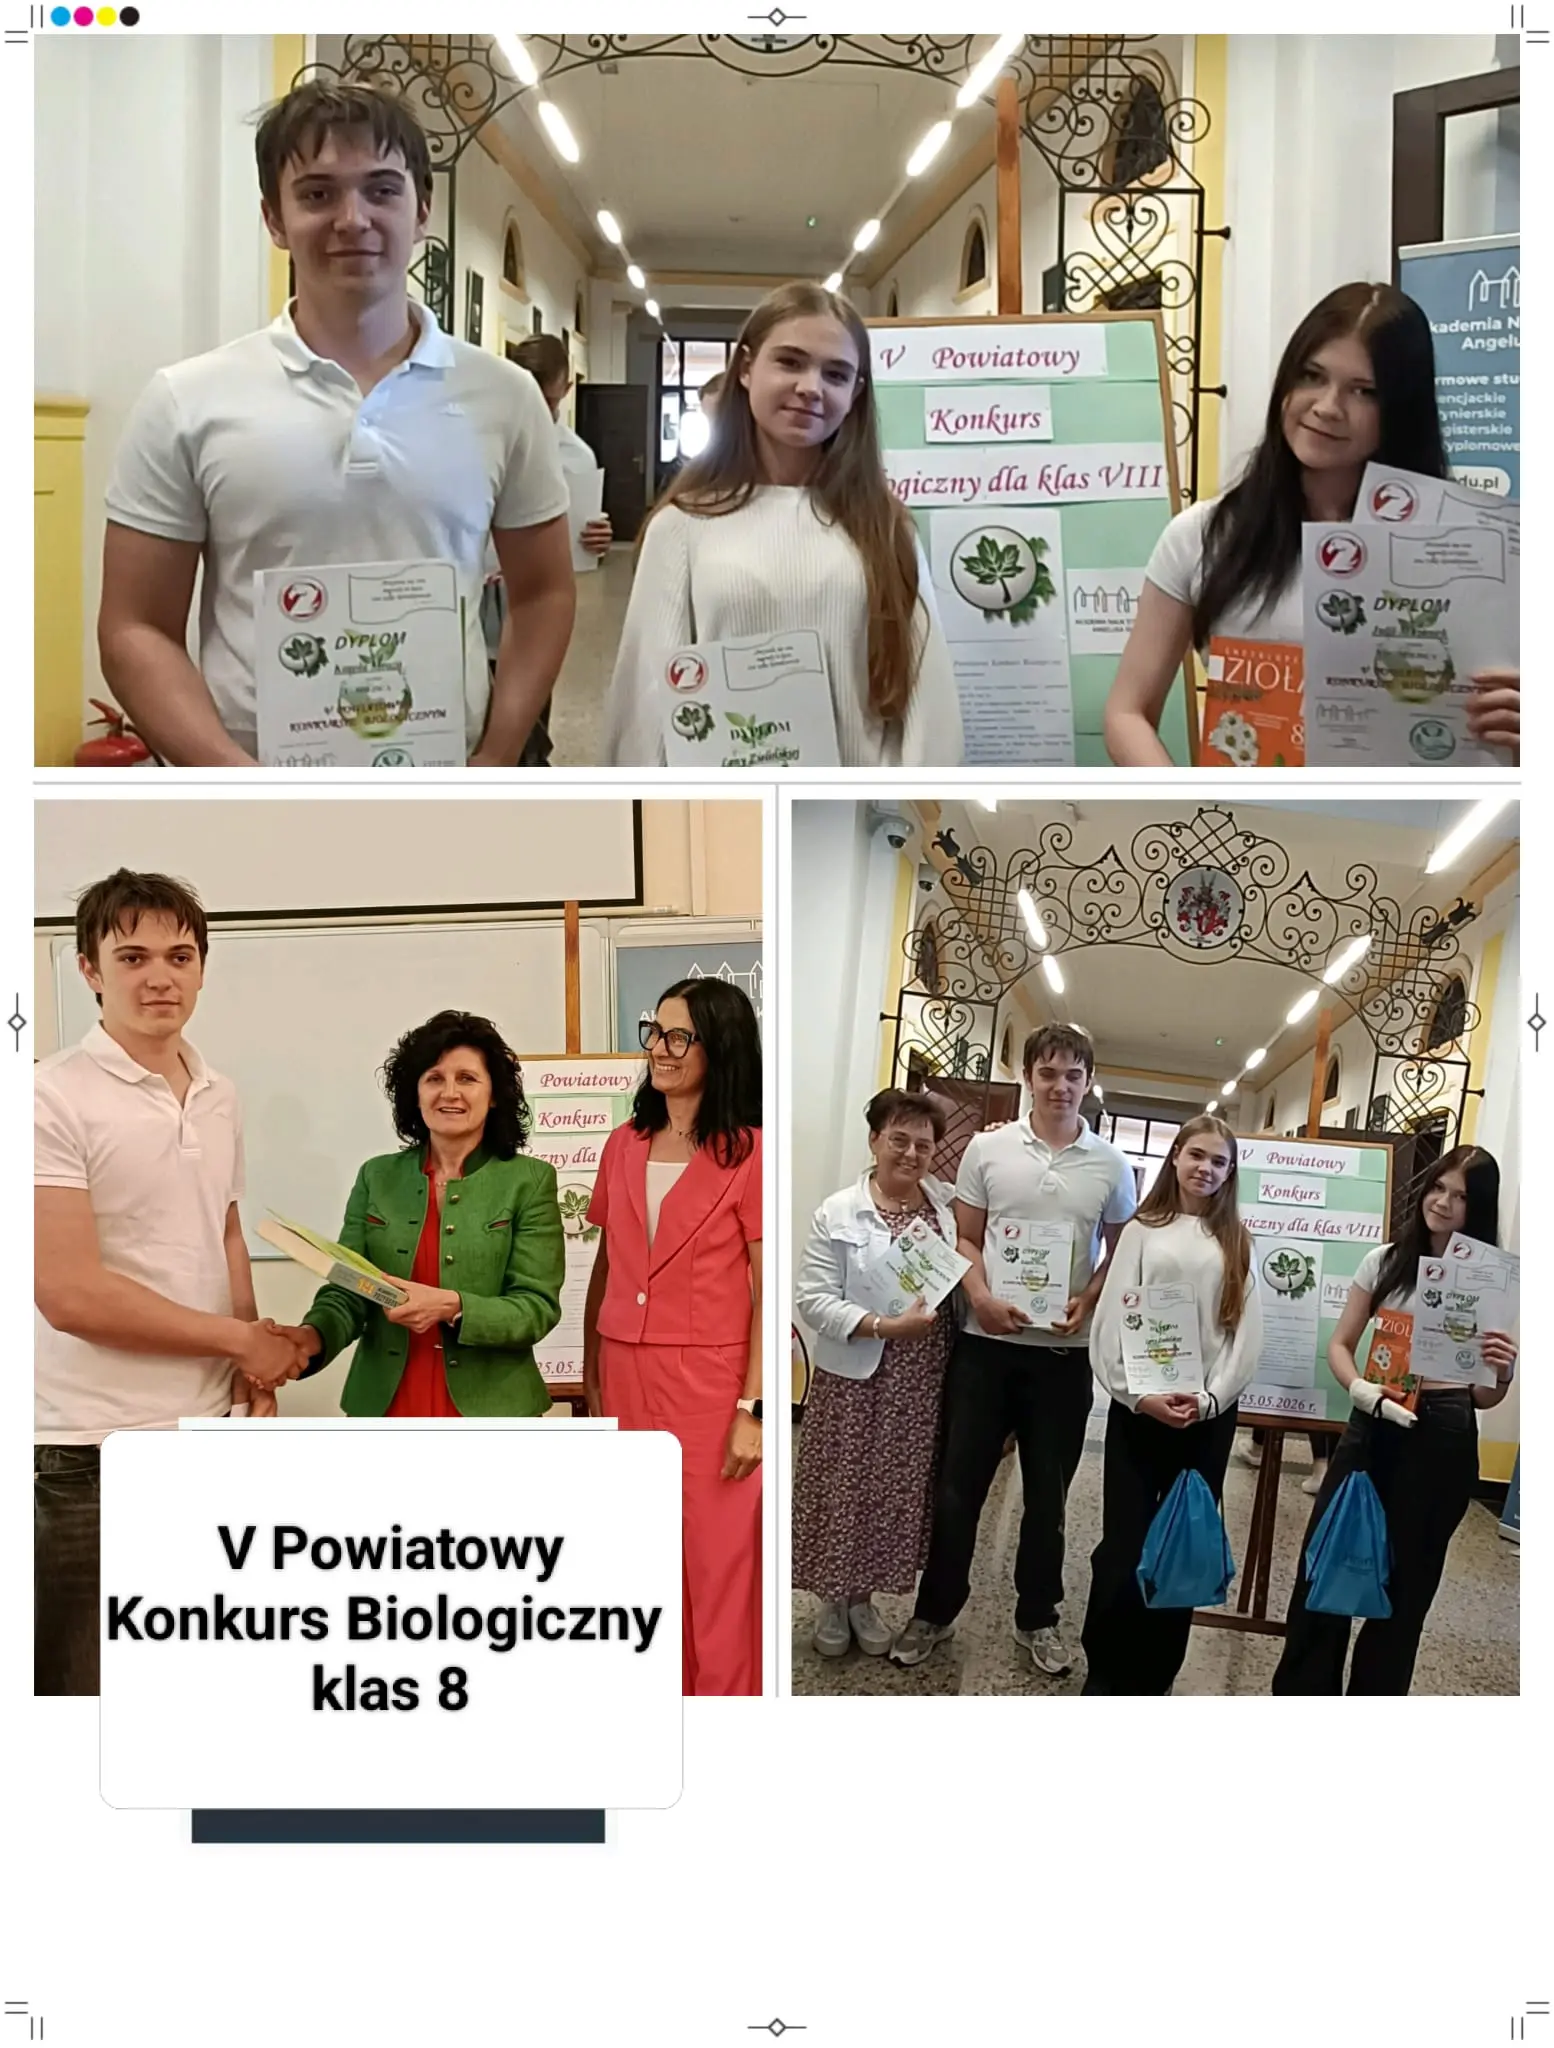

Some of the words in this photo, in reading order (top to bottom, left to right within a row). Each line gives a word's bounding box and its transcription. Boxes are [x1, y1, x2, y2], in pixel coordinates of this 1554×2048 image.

[1430, 317, 1502, 333] kademia
[1461, 333, 1519, 351] Angelu
[880, 346, 906, 369] V
[932, 345, 1080, 374] Powiatowy
[1434, 375, 1489, 385] rmowe
[1493, 373, 1519, 385] stu
[1437, 391, 1506, 406] encjackie
[929, 404, 1043, 435] Konkurs
[1439, 407, 1507, 421] ynierskie
[1442, 423, 1513, 437] gisterskie
[988, 466, 1027, 493] dla
[1038, 464, 1089, 496] klas
[1098, 462, 1163, 489] VIII
[1456, 474, 1499, 489] du.pl
[1374, 597, 1451, 613] DYPLOM
[334, 631, 406, 650] DYPLOM
[540, 1072, 632, 1091] Powiatowy
[538, 1110, 607, 1128] Konkurs
[572, 1146, 597, 1163] dla
[1240, 1149, 1254, 1161] V
[1266, 1151, 1346, 1173] Powiatowy
[1261, 1184, 1321, 1202] Konkurs
[1287, 1217, 1310, 1234] dla
[1313, 1219, 1342, 1236] klas
[1346, 1222, 1382, 1239] VIII
